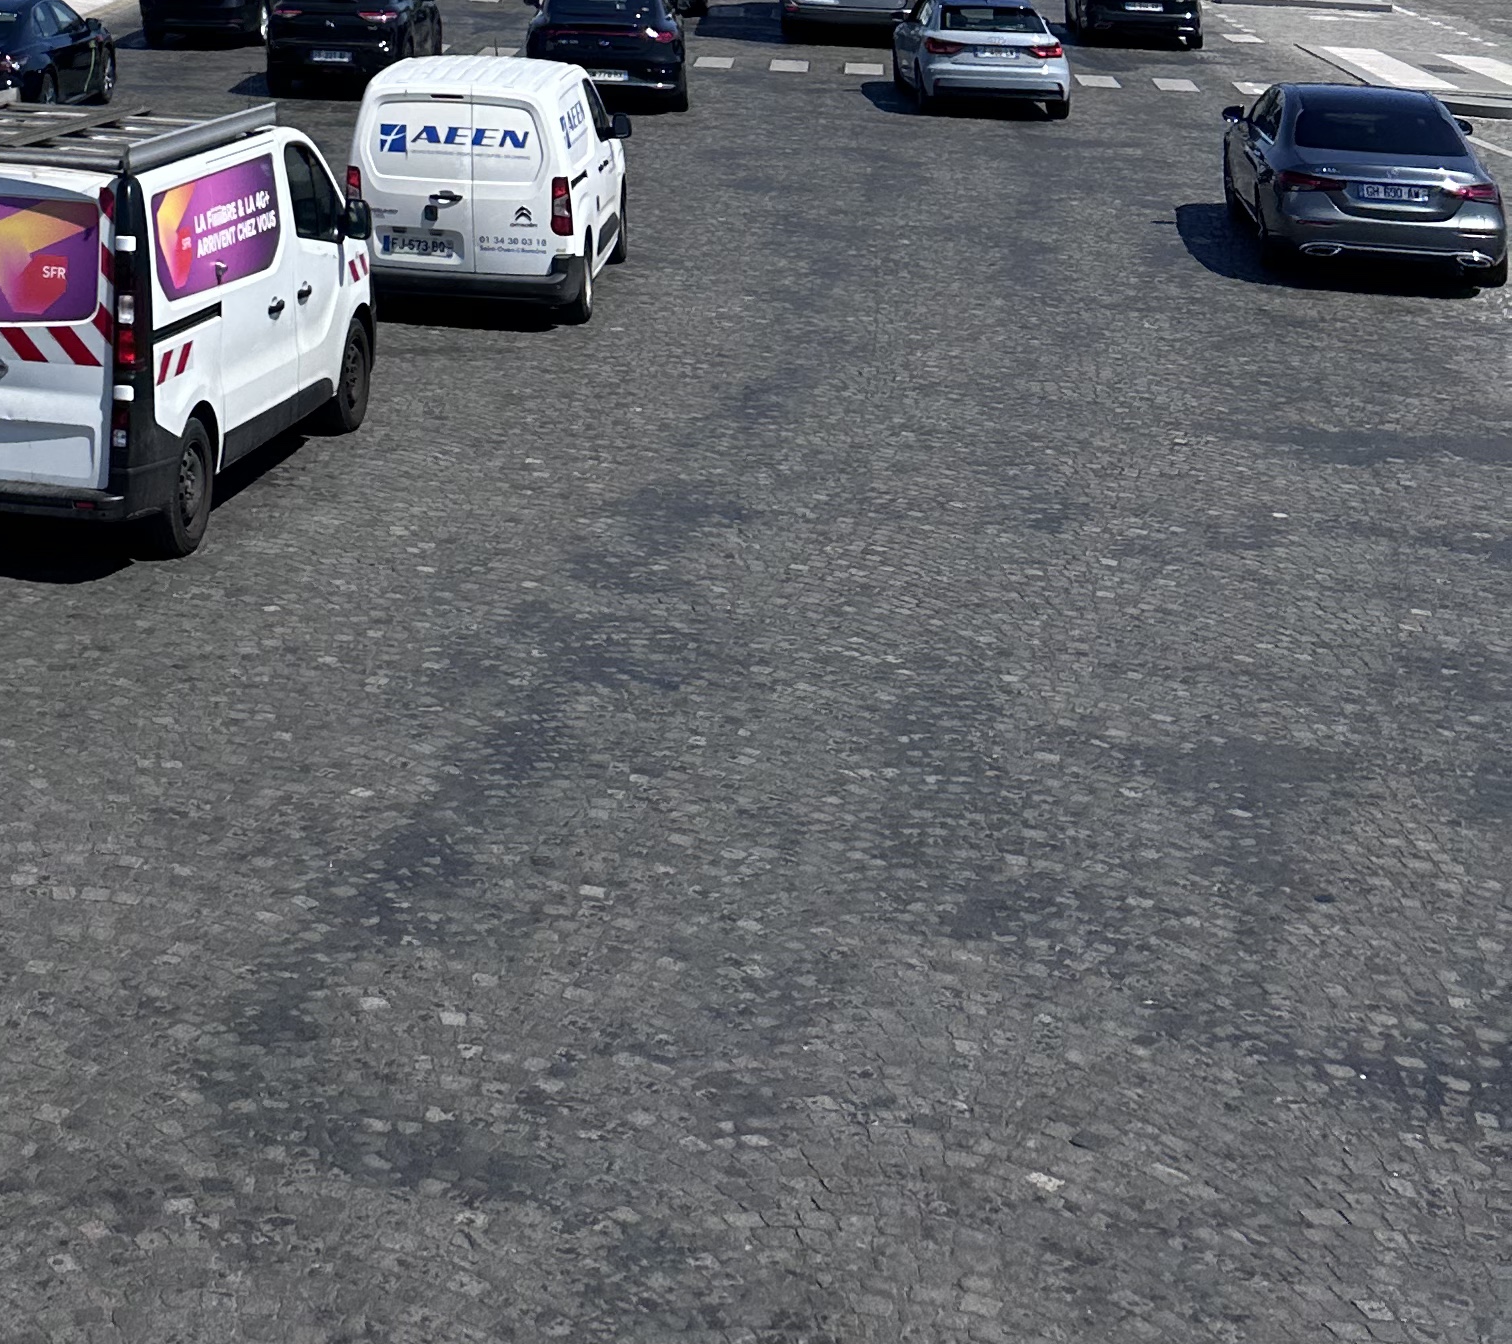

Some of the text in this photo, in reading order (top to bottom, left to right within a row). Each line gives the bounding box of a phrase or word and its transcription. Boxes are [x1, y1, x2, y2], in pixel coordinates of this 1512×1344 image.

[410, 125, 530, 149] AEEN
[194, 213, 207, 234] LA
[237, 199, 245, 218] &
[244, 195, 256, 215] LA
[197, 210, 276, 258] ARRIVENT CHEZ VOUS
[42, 265, 67, 280] SFR
